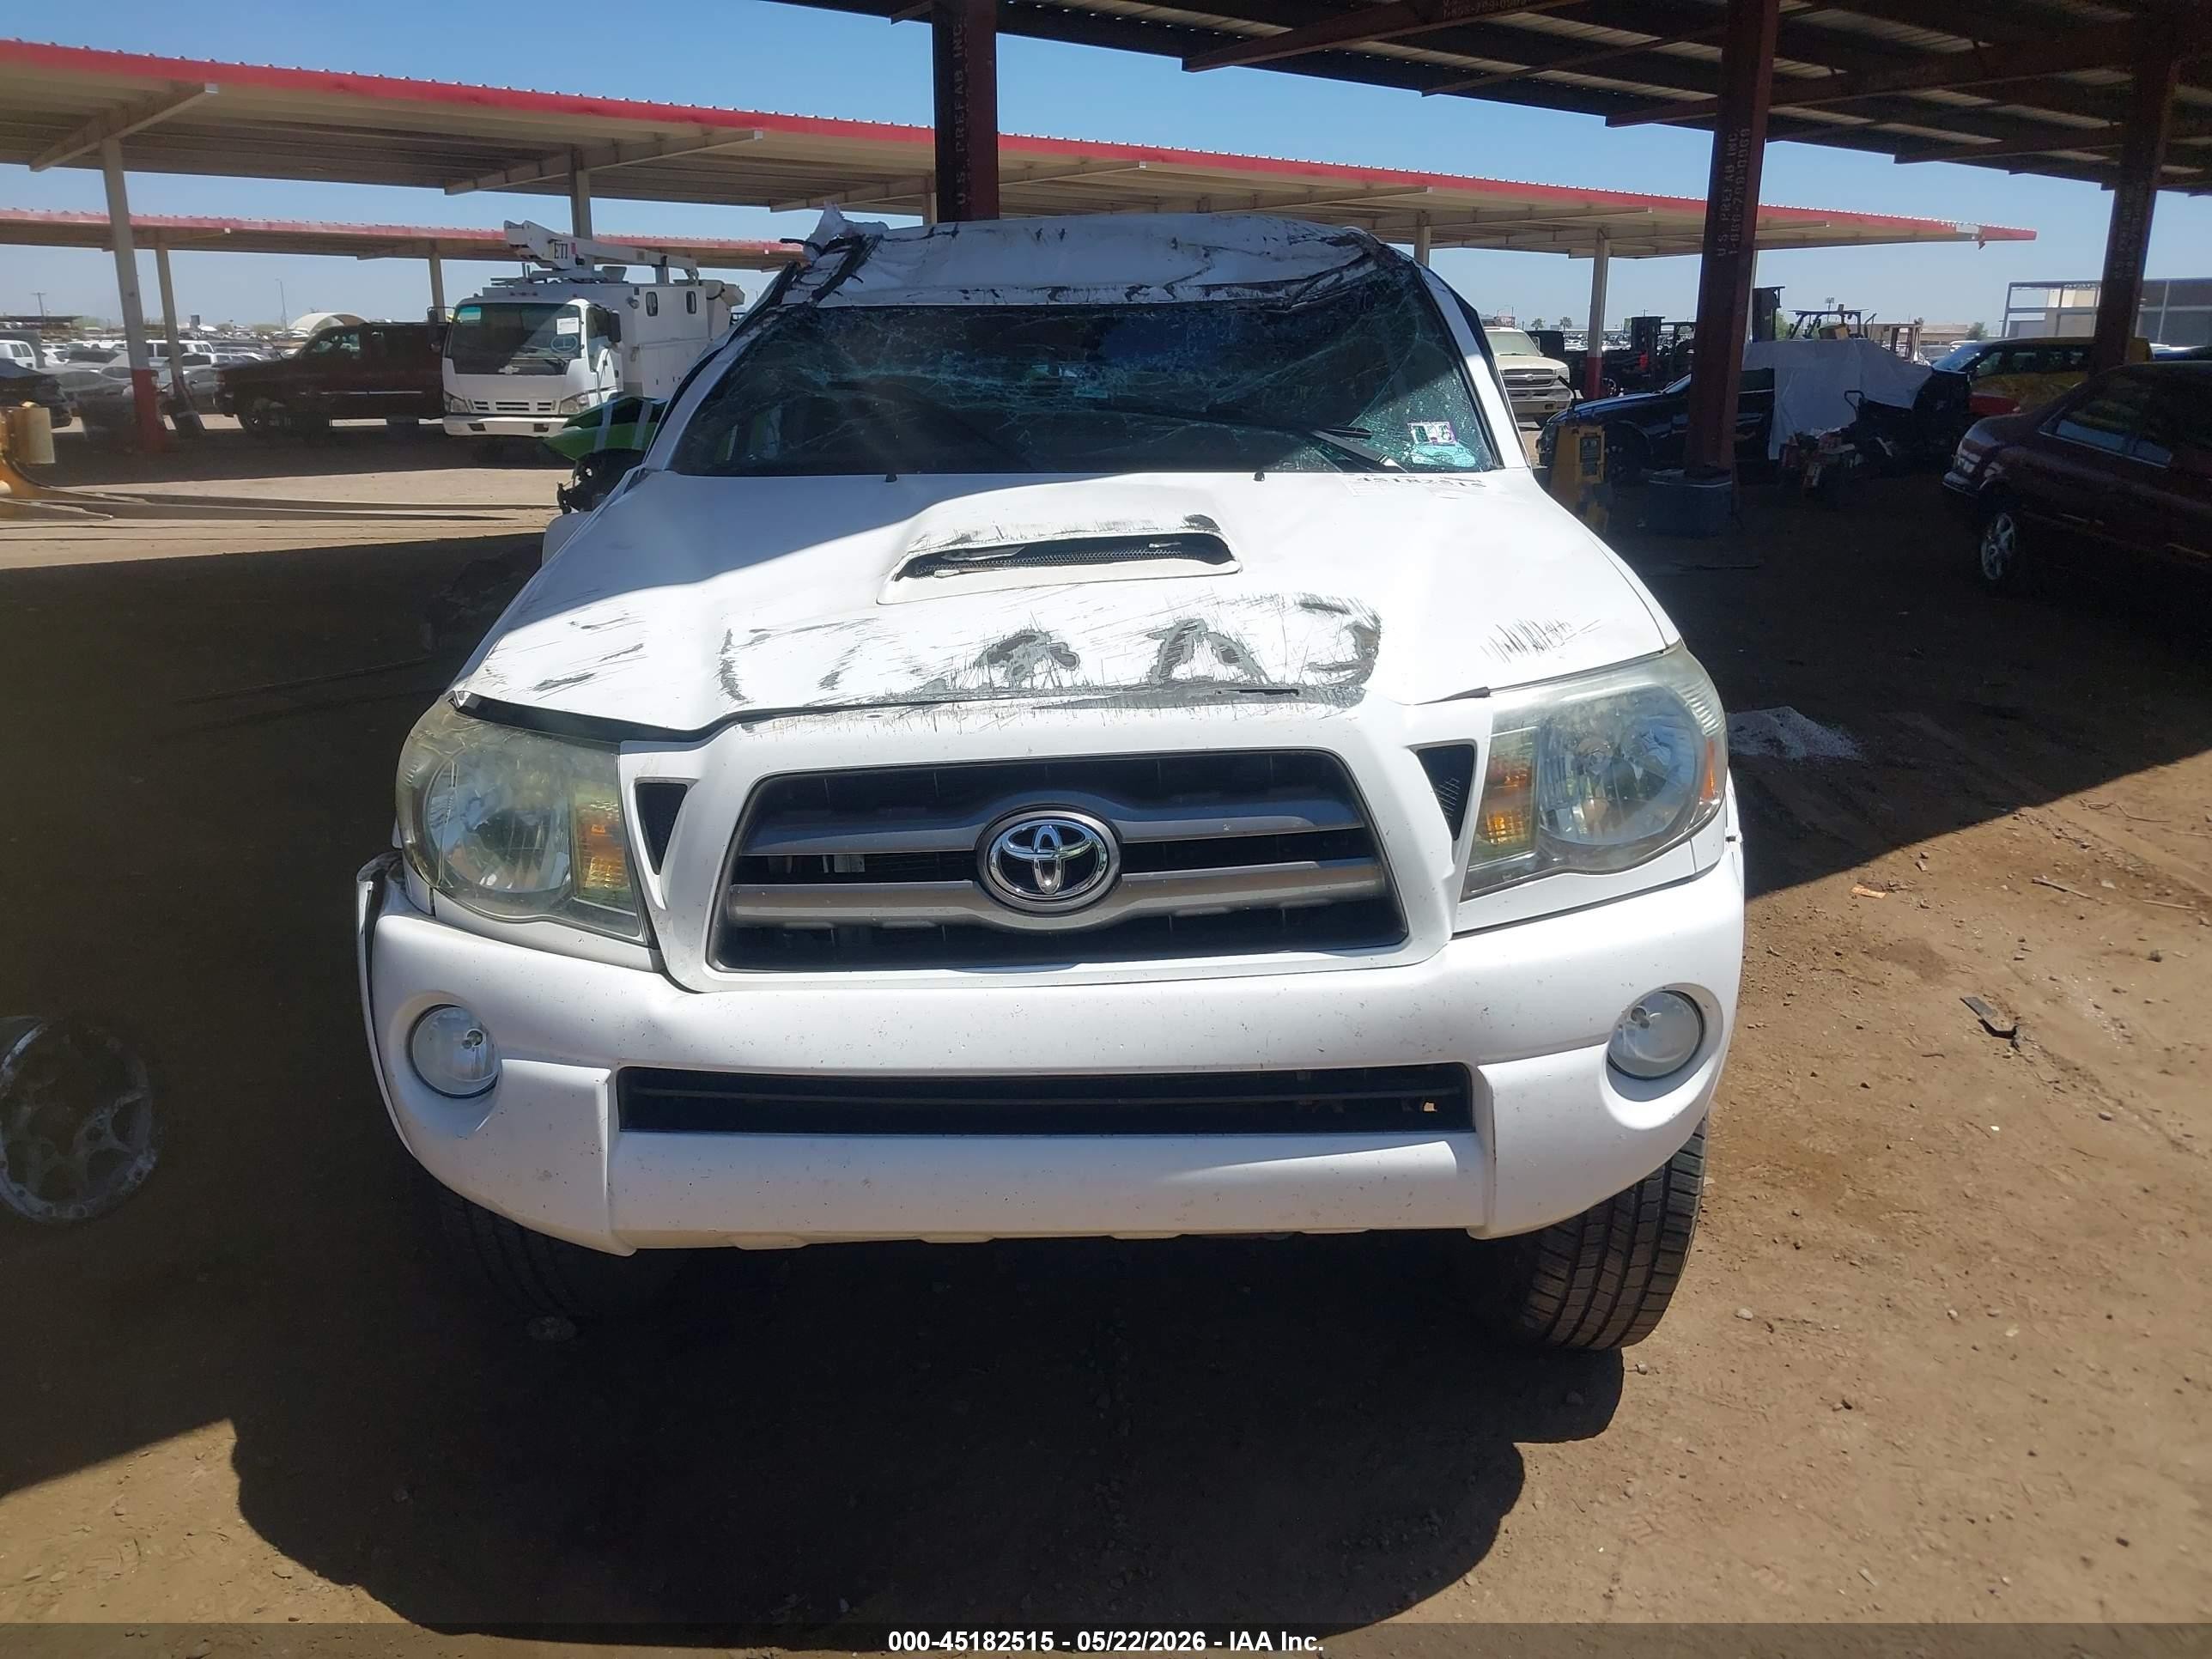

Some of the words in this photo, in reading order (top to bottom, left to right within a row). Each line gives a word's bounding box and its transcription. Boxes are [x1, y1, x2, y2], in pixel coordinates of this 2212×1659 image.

[954, 69, 964, 153] PREFAB
[1720, 164, 1735, 221] PREFAB
[554, 243, 568, 259] ETI
